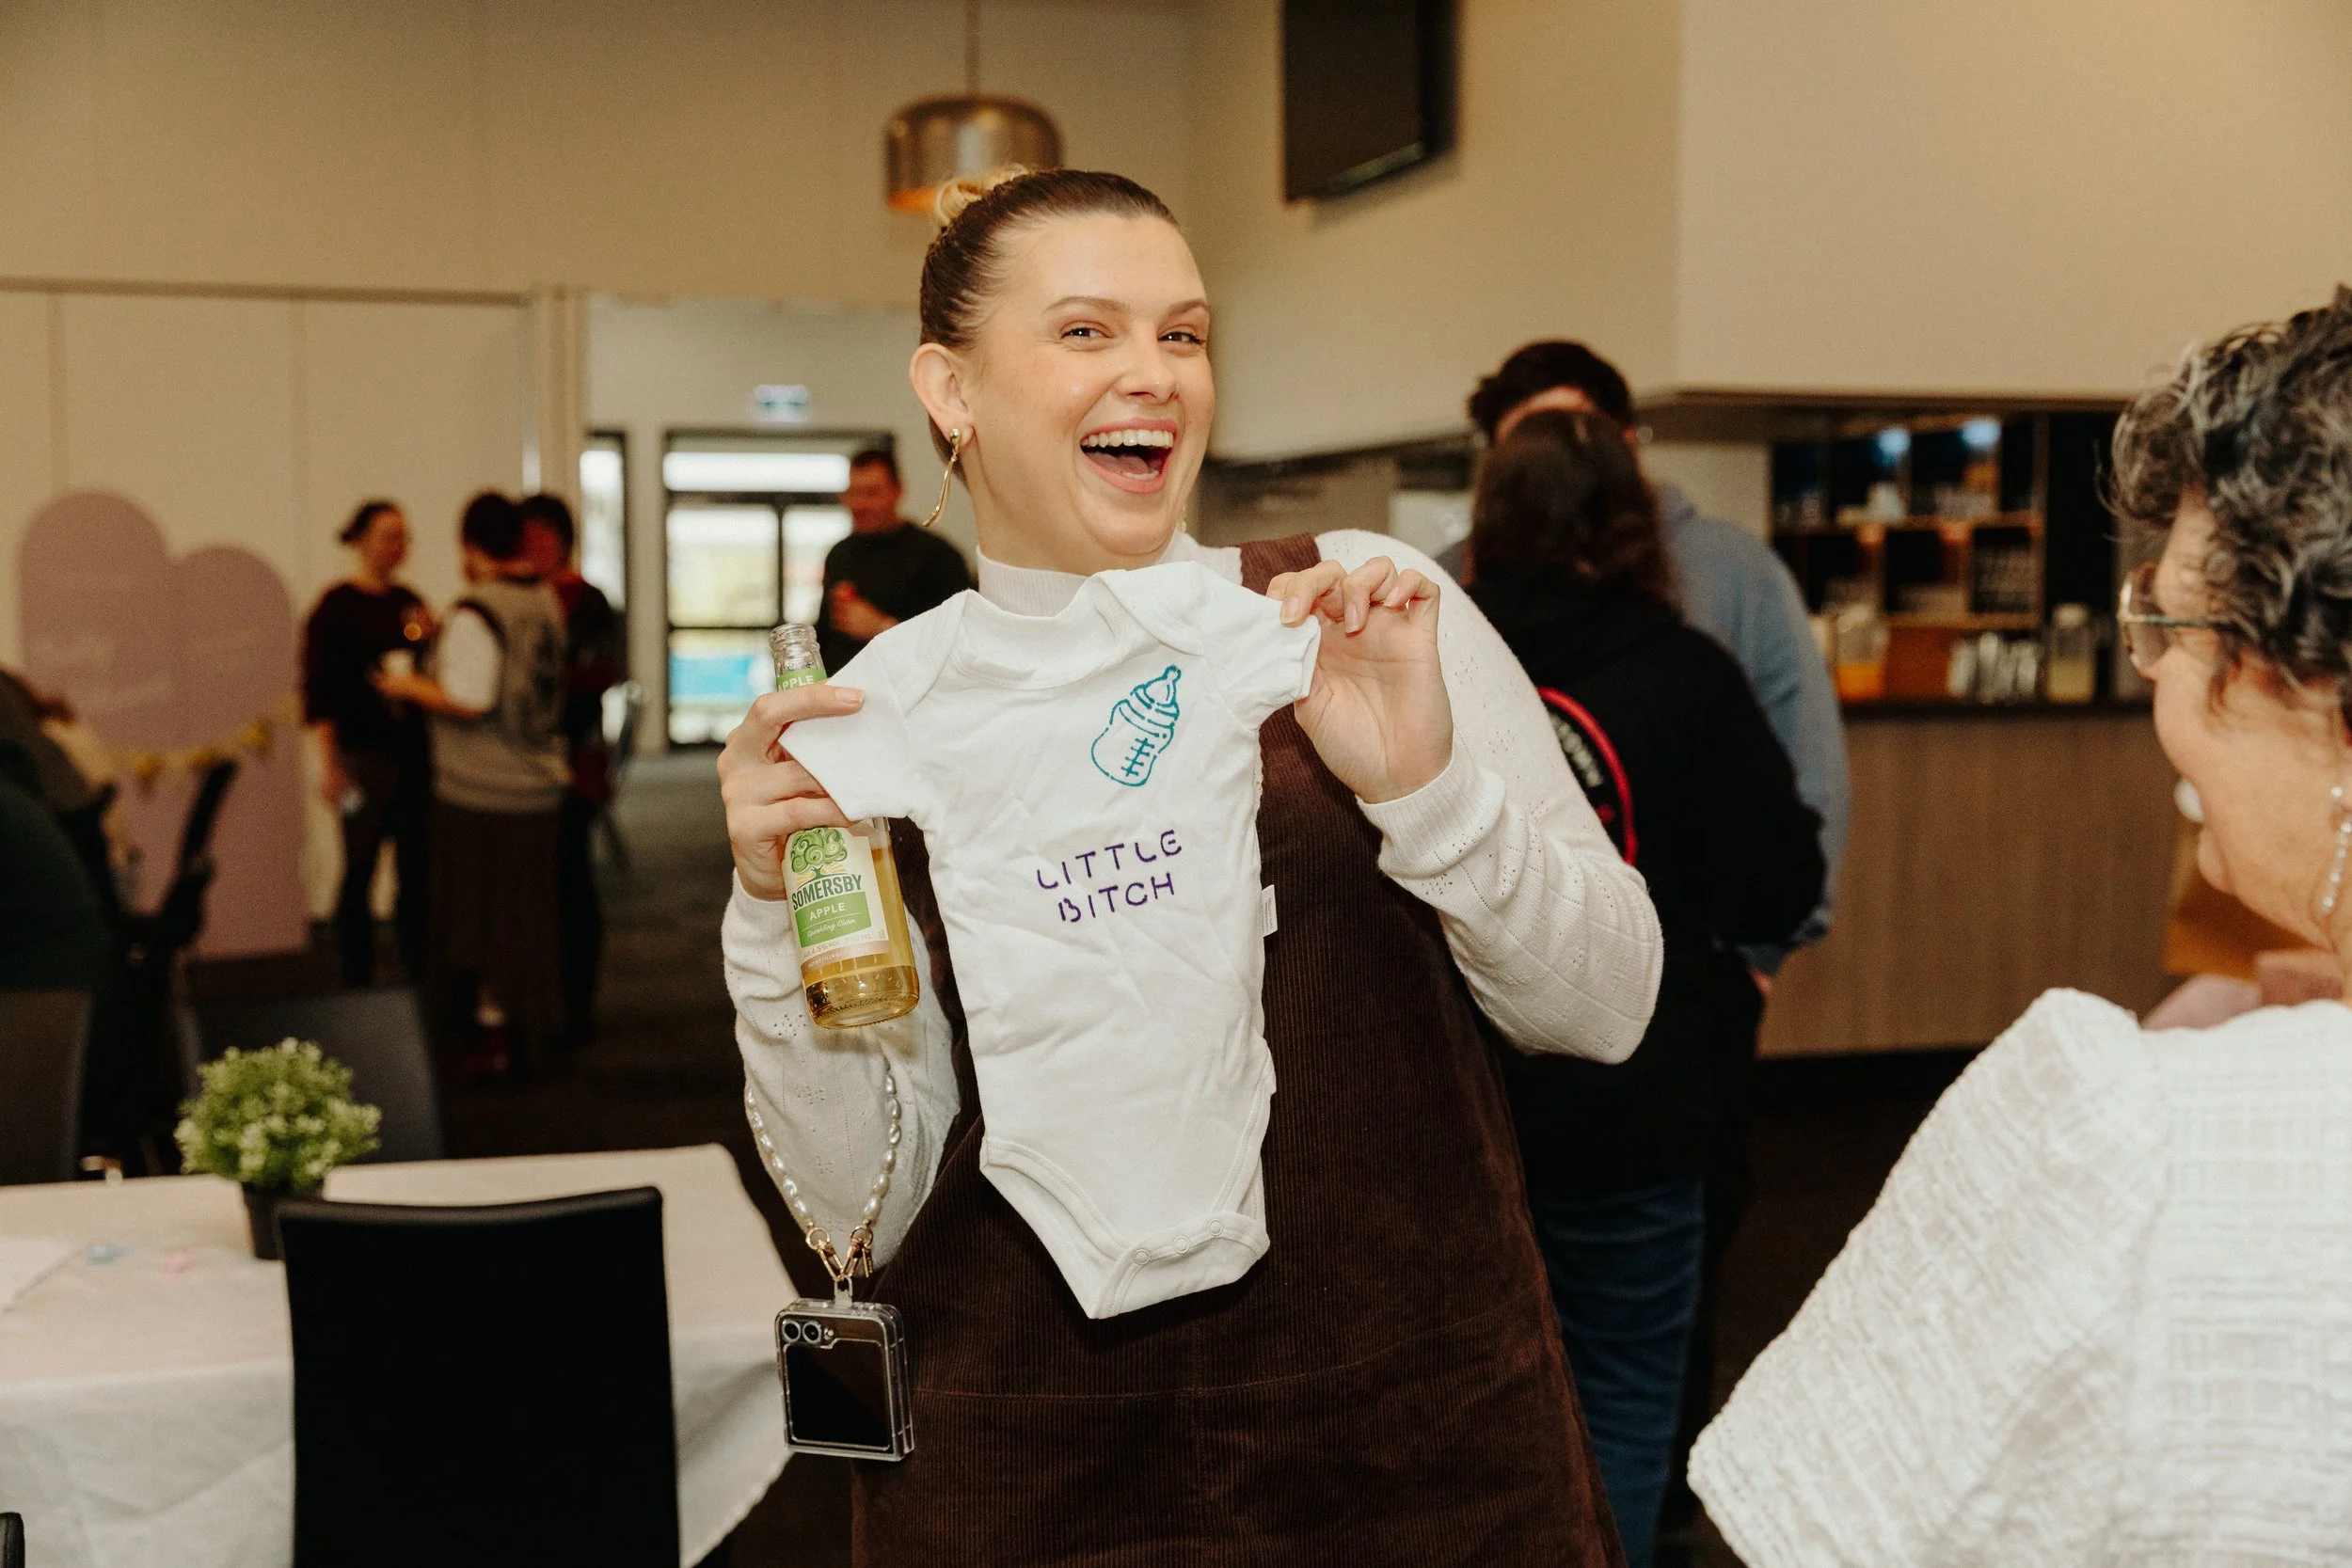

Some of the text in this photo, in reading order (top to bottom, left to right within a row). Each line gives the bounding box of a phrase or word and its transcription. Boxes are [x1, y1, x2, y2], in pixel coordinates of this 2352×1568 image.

[777, 674, 814, 692] APPLE
[1037, 830, 1182, 890] LITTLE
[791, 873, 862, 911] SOMERSBY
[1057, 872, 1174, 923] BITCH
[809, 902, 846, 921] APPLE
